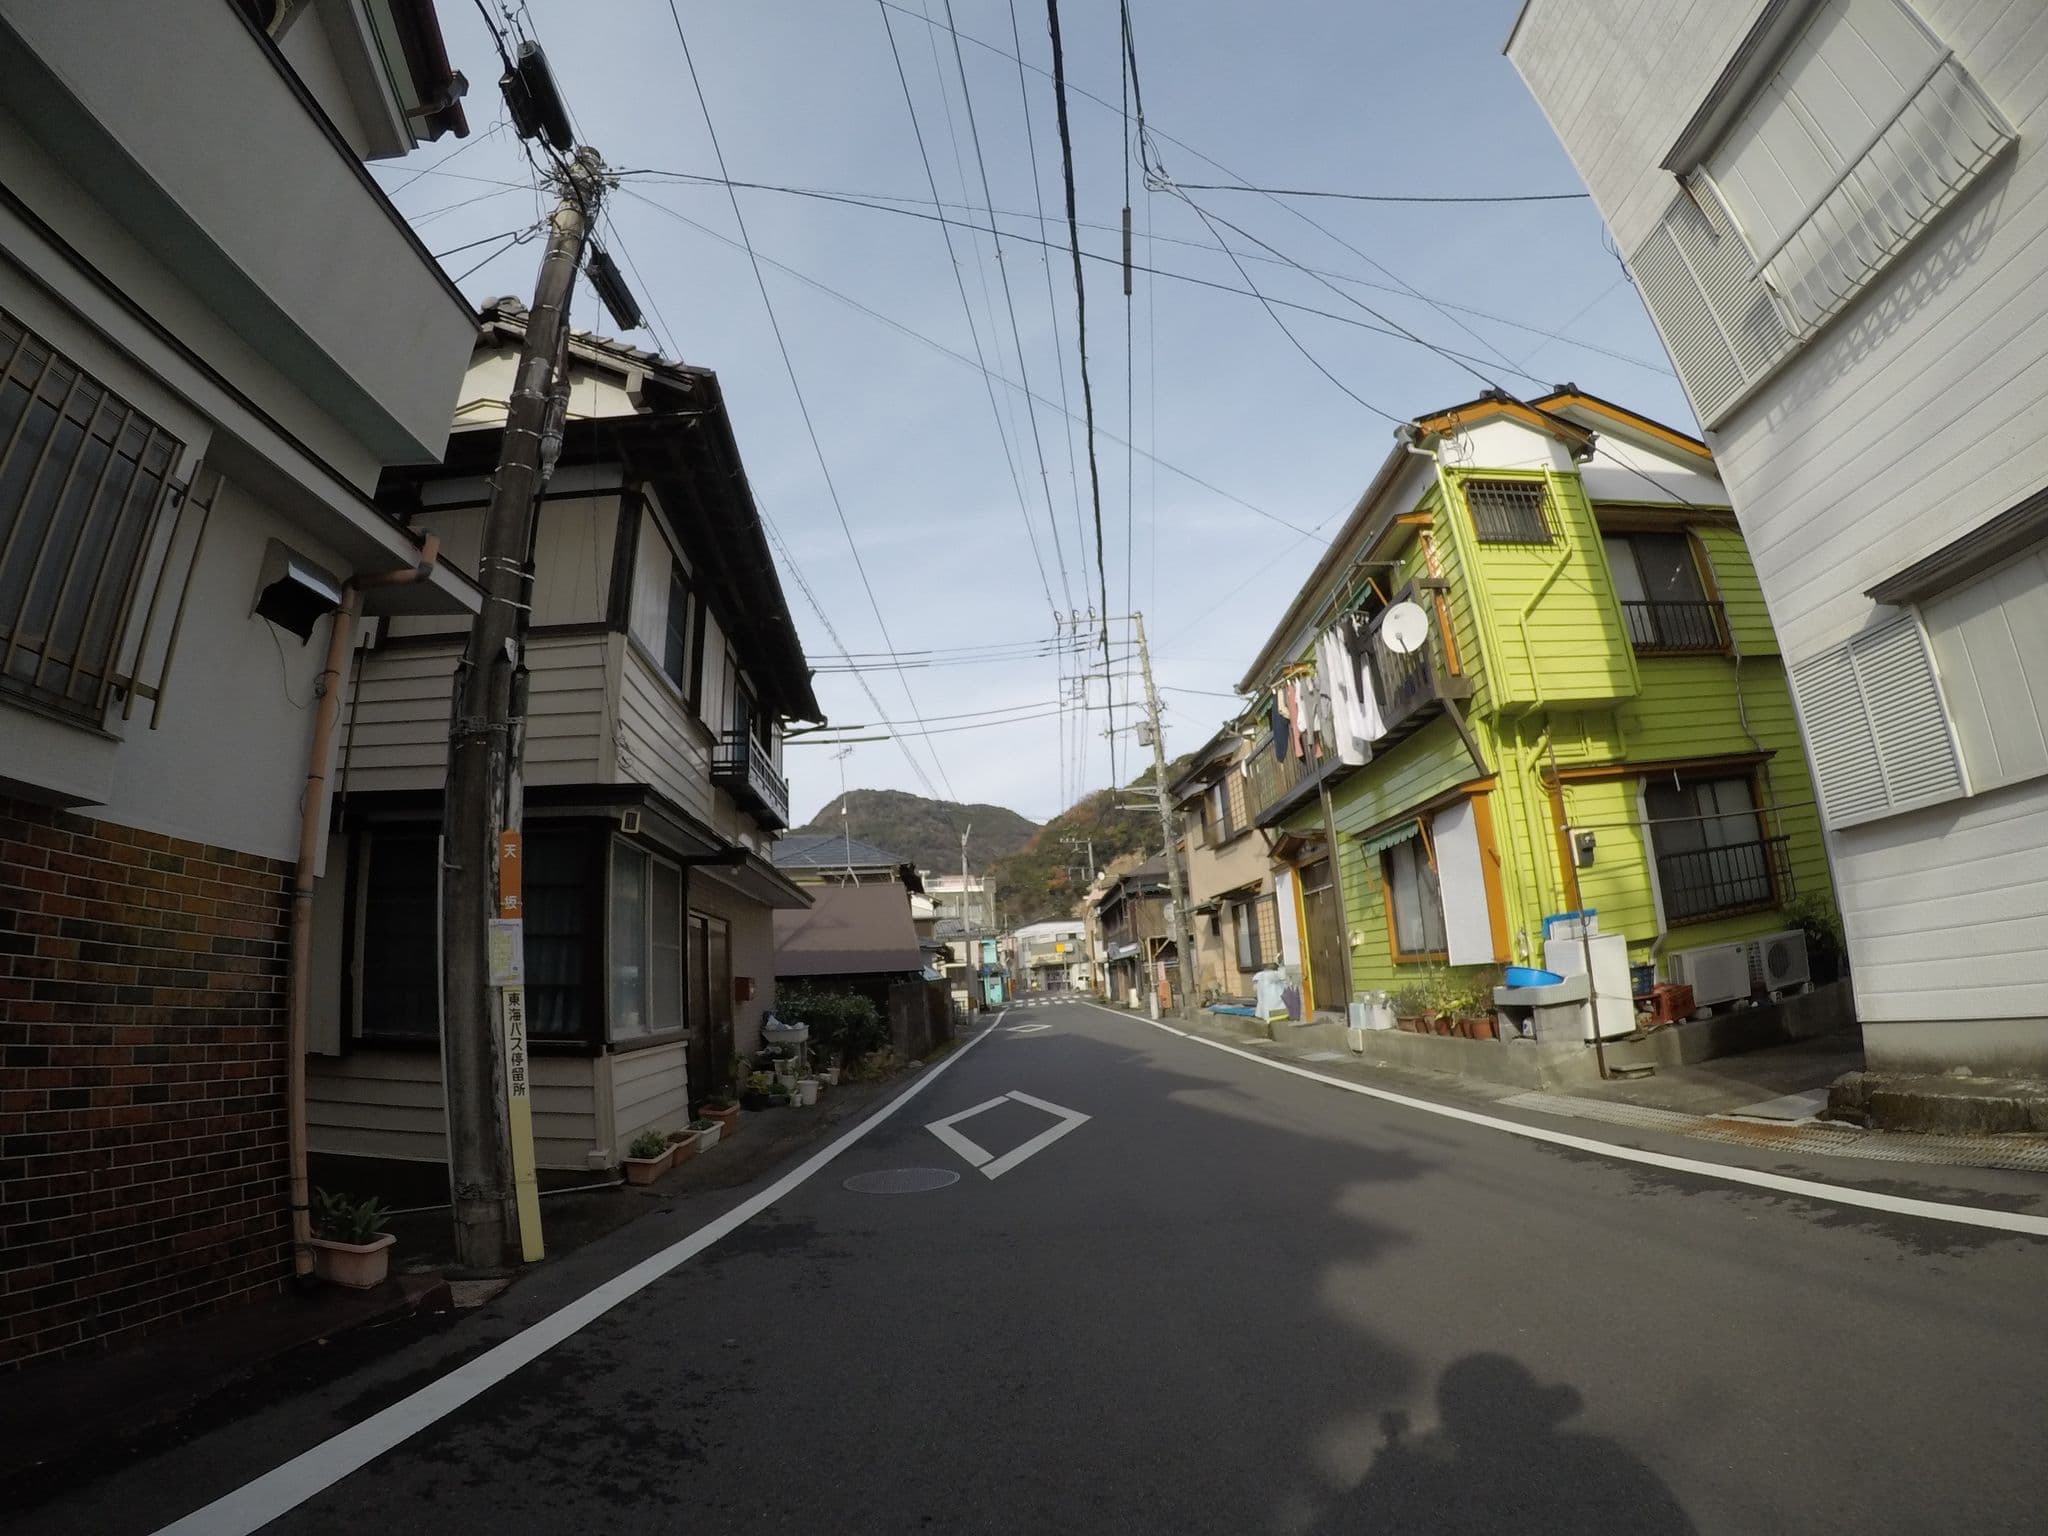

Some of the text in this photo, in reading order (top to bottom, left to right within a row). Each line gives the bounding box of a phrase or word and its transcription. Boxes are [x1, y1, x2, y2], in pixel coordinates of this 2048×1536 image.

[508, 993, 526, 1096] 東海バス停留所
